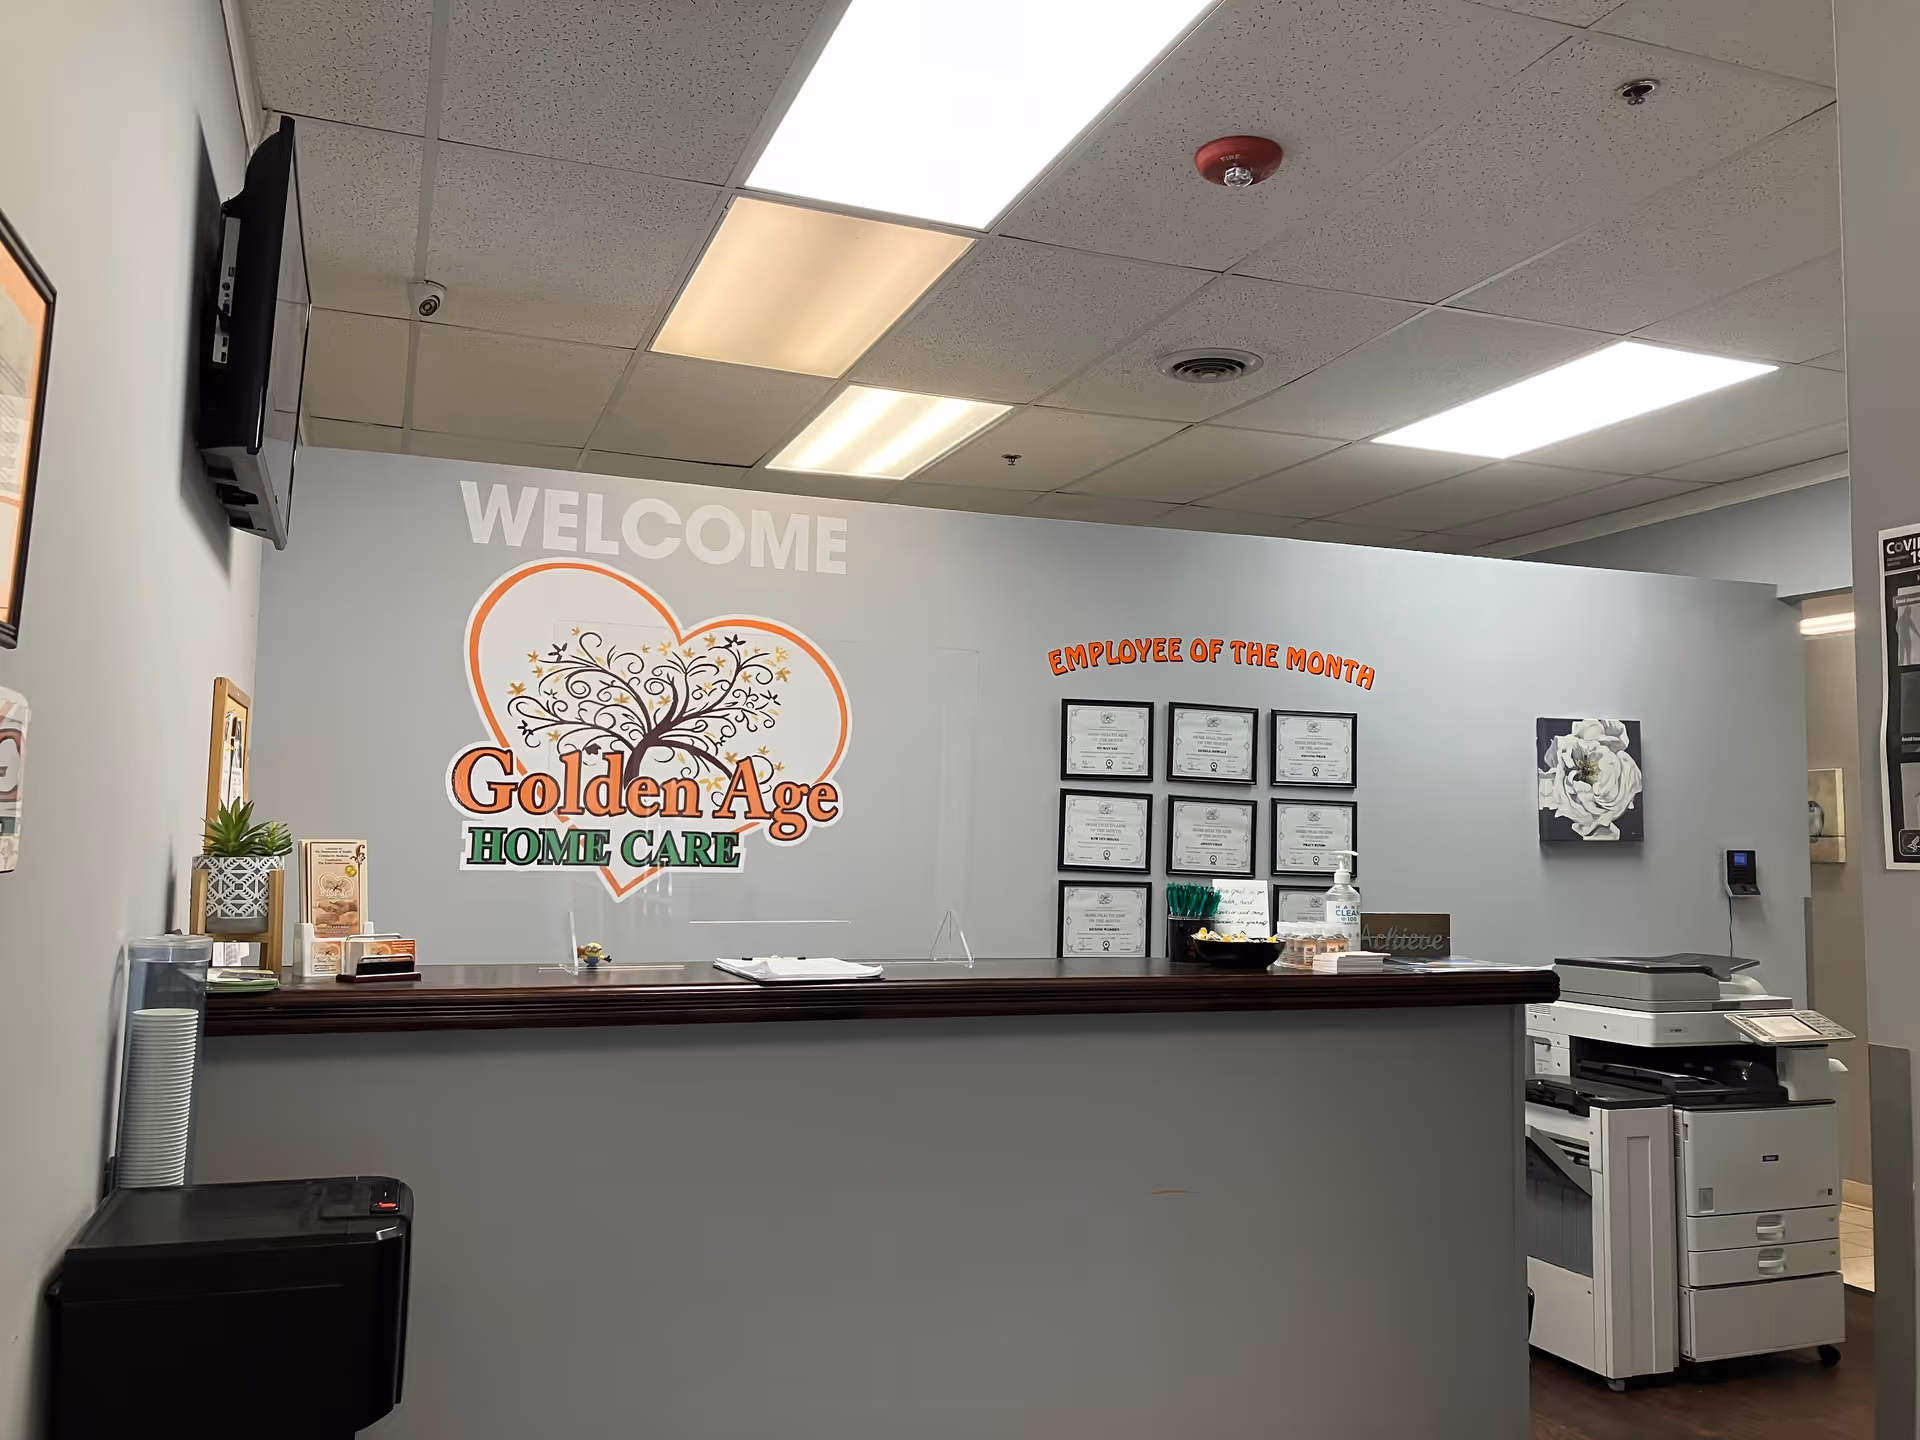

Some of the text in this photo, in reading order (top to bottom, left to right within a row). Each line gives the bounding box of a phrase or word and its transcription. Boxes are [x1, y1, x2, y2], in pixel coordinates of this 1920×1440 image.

[1219, 153, 1241, 162] FIRE
[460, 480, 849, 575] WELCOME
[1886, 537, 1920, 555] COVI
[1048, 637, 1376, 691] EMPLOYEE OF THE MONTH
[451, 746, 839, 841] Golden Age
[467, 825, 741, 868] HOME CARE
